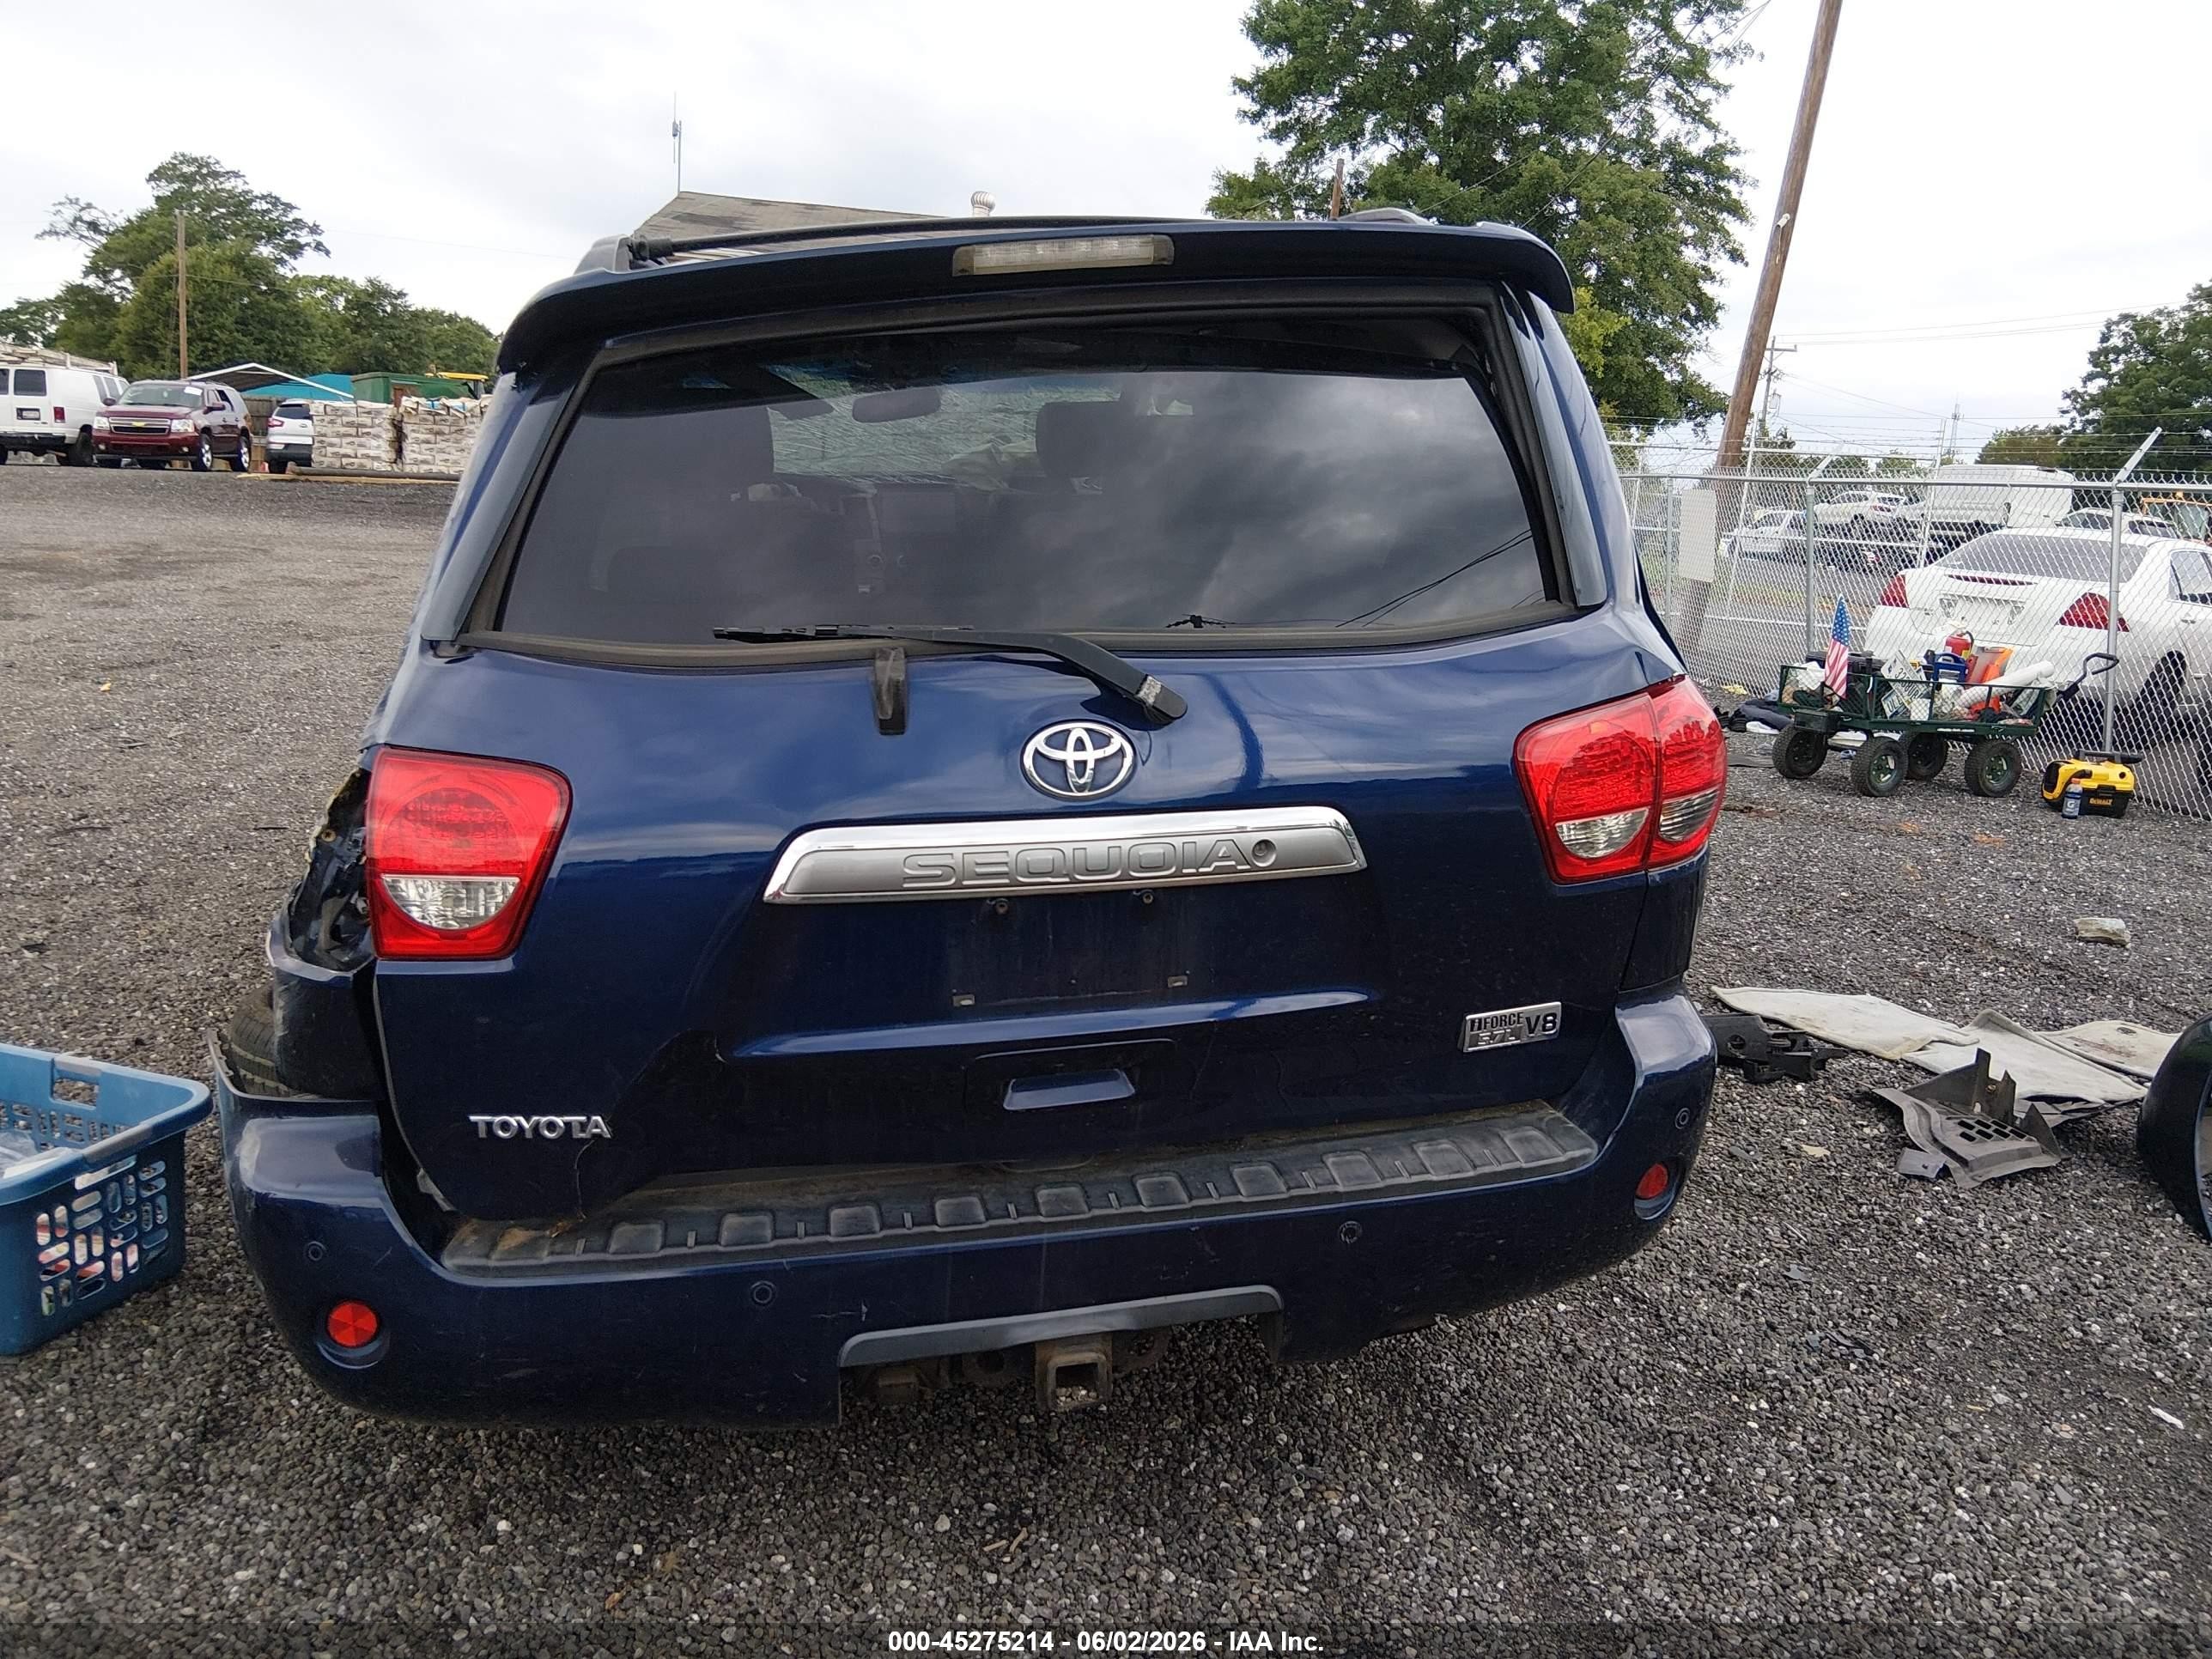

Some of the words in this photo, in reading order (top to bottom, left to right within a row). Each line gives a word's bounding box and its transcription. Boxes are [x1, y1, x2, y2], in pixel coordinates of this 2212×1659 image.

[902, 838, 1251, 888] SEQUOIA
[1524, 1012, 1558, 1036] V8
[469, 1115, 611, 1139] TOYOTA
